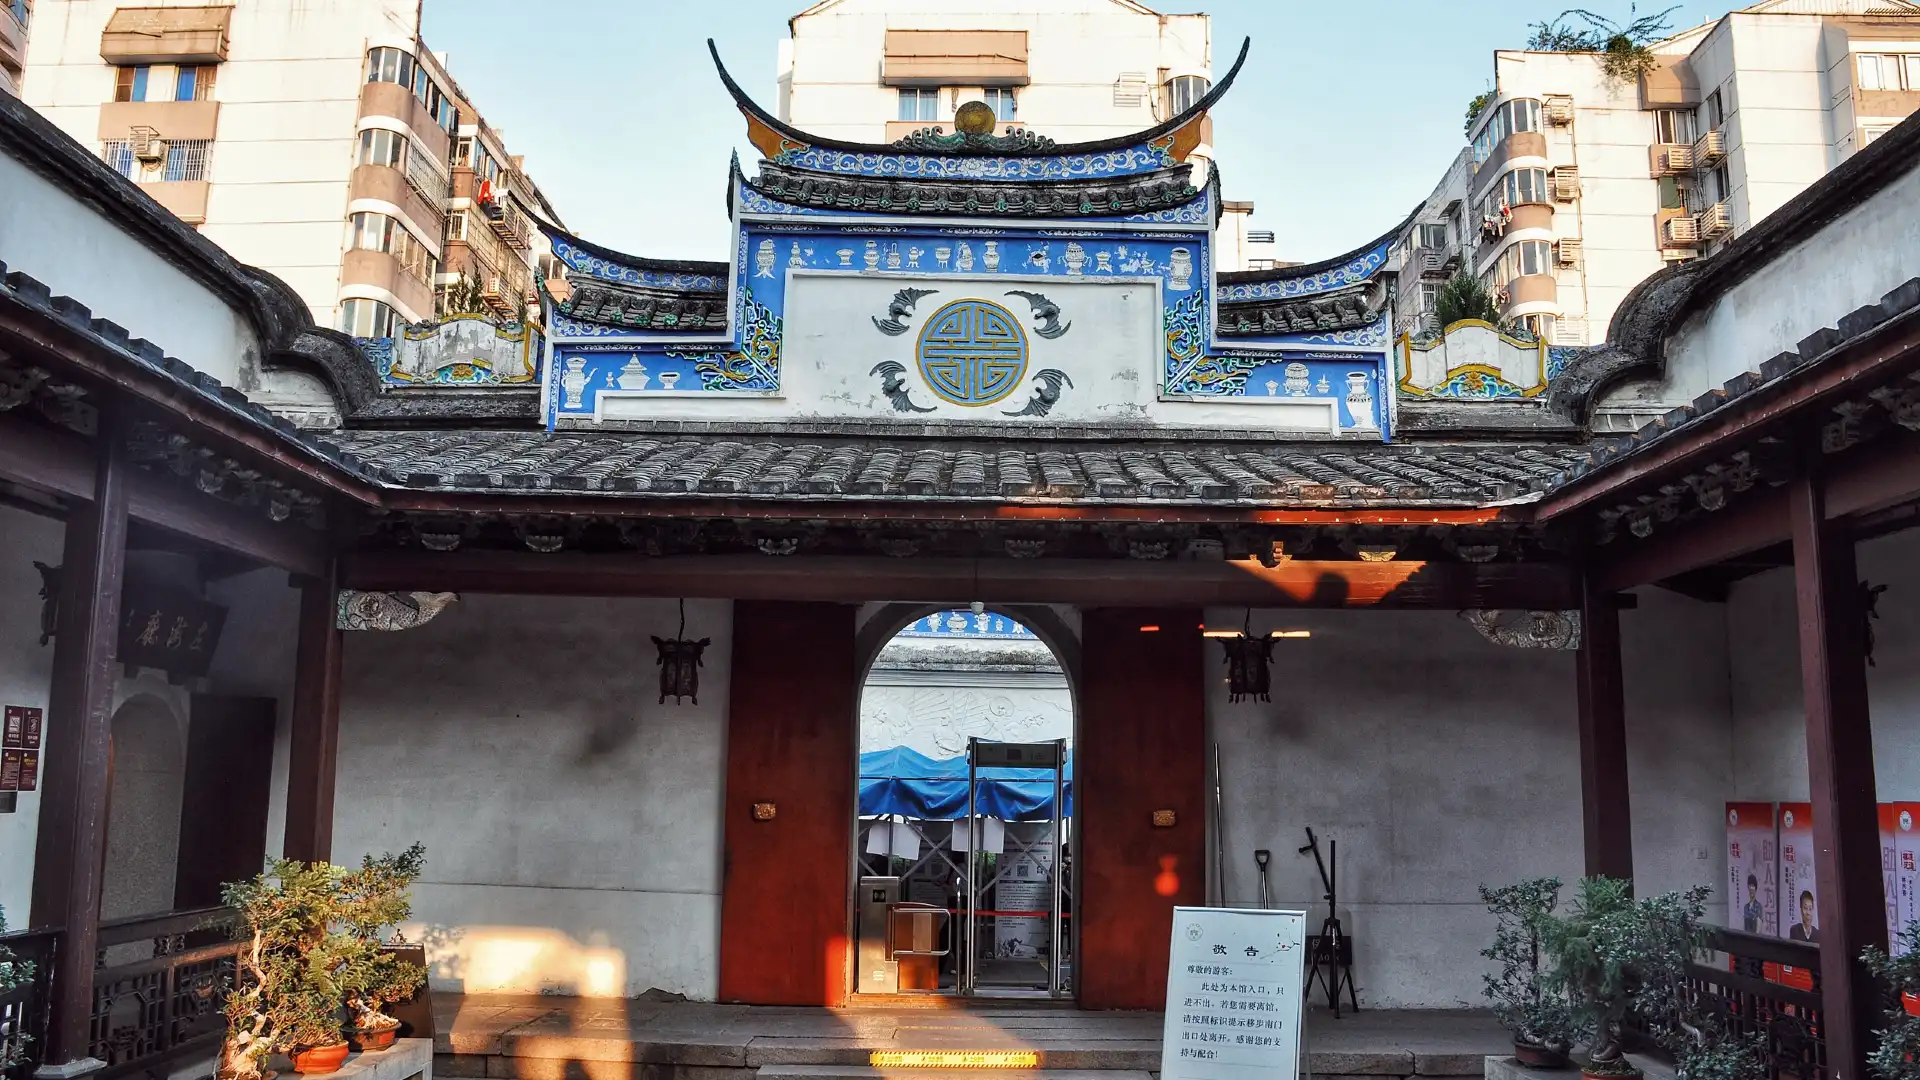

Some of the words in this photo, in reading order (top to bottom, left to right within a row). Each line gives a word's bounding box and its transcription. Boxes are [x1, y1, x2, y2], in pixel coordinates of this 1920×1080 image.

[1762, 839, 1776, 934] 助人为乐
[1212, 944, 1260, 957] 敬告
[1187, 964, 1233, 976] 尊敬的游客：
[1201, 982, 1285, 995] 此处为本馆入口，只
[1183, 1014, 1282, 1030] 请按照标识提示移步南门
[1181, 1031, 1281, 1047] 出口处离开。感谢您的支
[1180, 1047, 1219, 1060] 持与配合！
